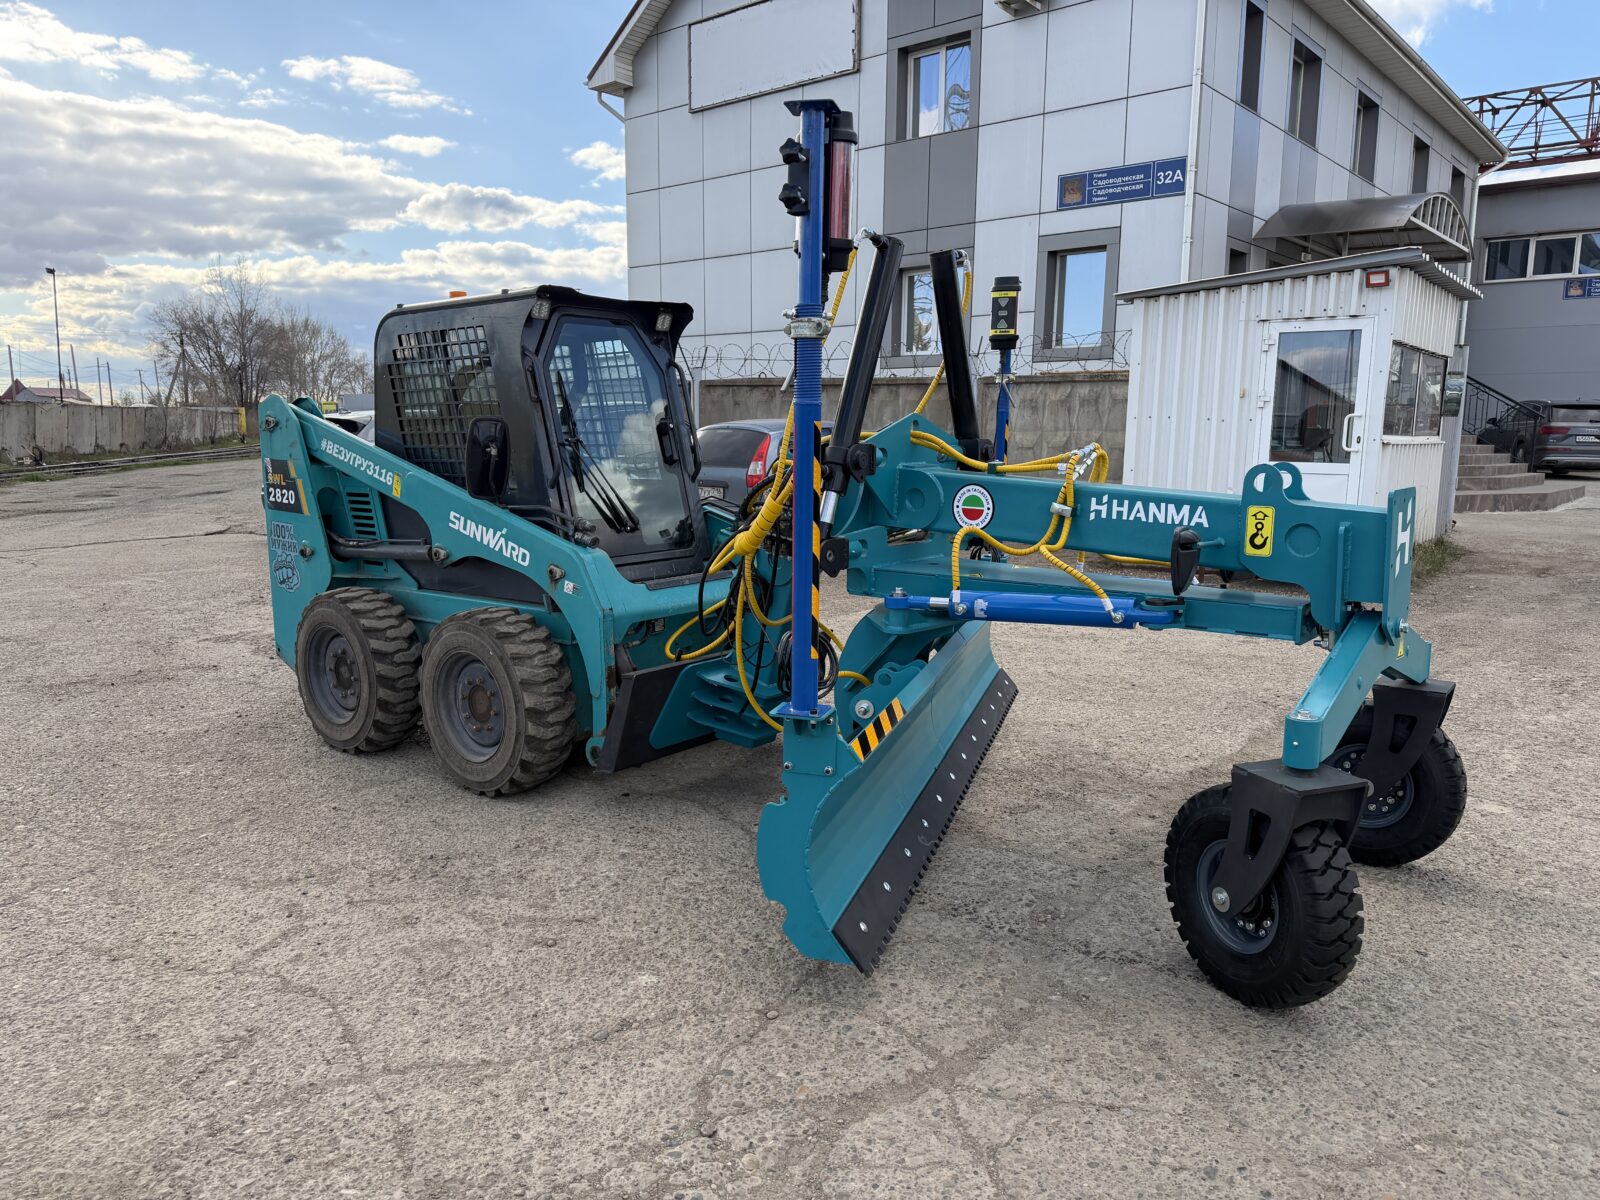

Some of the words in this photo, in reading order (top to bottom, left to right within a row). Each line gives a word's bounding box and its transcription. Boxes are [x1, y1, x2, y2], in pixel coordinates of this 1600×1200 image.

[1092, 174, 1144, 186] Садоводческая
[1156, 169, 1184, 185] 32А
[1092, 183, 1144, 196] Садоводческая
[268, 487, 296, 505] 2820
[1111, 498, 1209, 528] HANMA
[272, 522, 294, 540] 100%
[448, 510, 531, 567] SUNWARD
